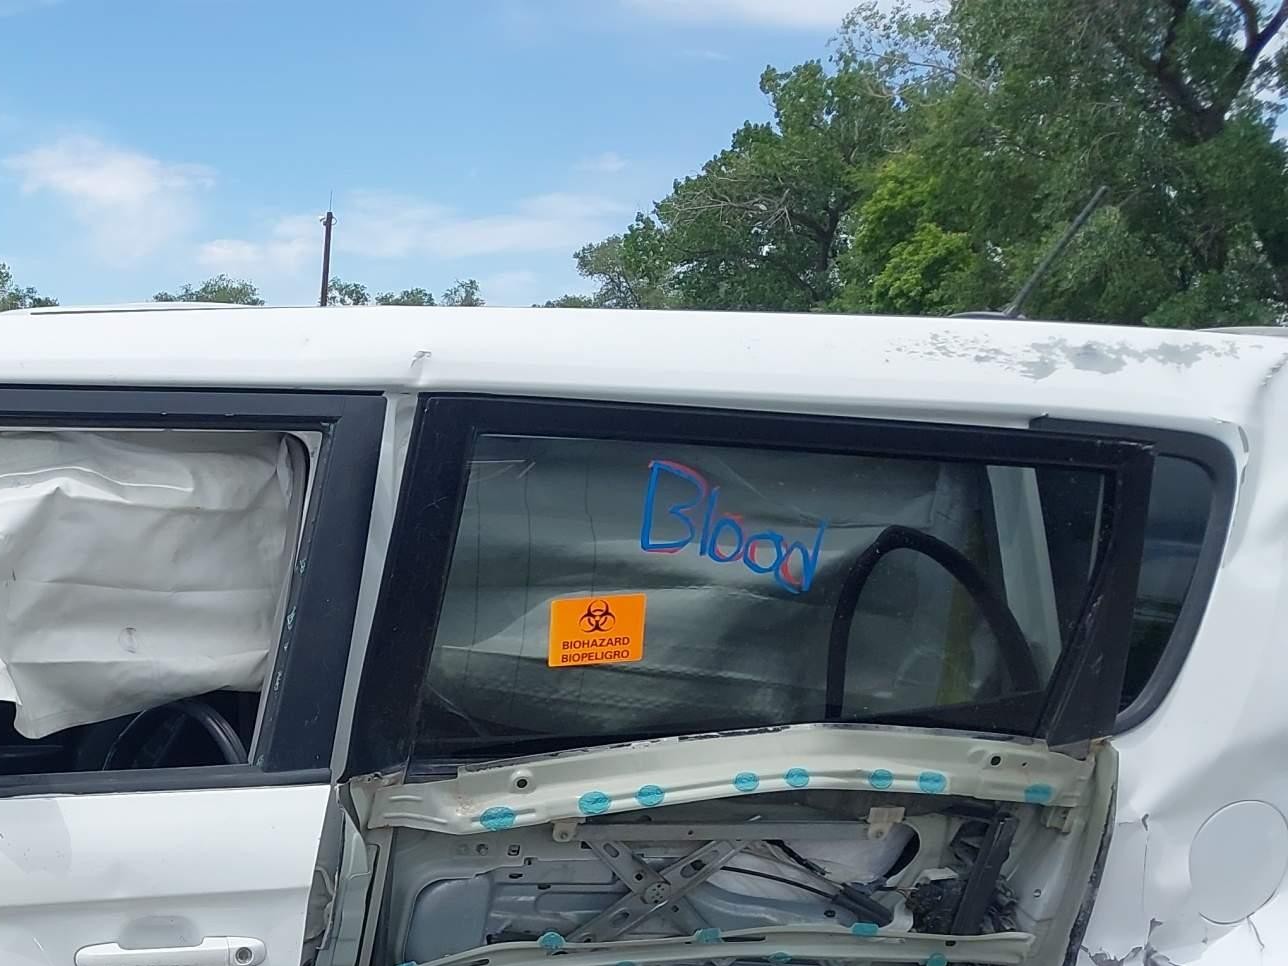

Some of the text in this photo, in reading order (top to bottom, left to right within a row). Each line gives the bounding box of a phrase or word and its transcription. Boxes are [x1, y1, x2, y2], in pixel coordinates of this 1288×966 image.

[641, 459, 829, 595] Blood
[562, 636, 630, 650] BIOHAZARD
[561, 649, 630, 663] BIOPELIGRO
